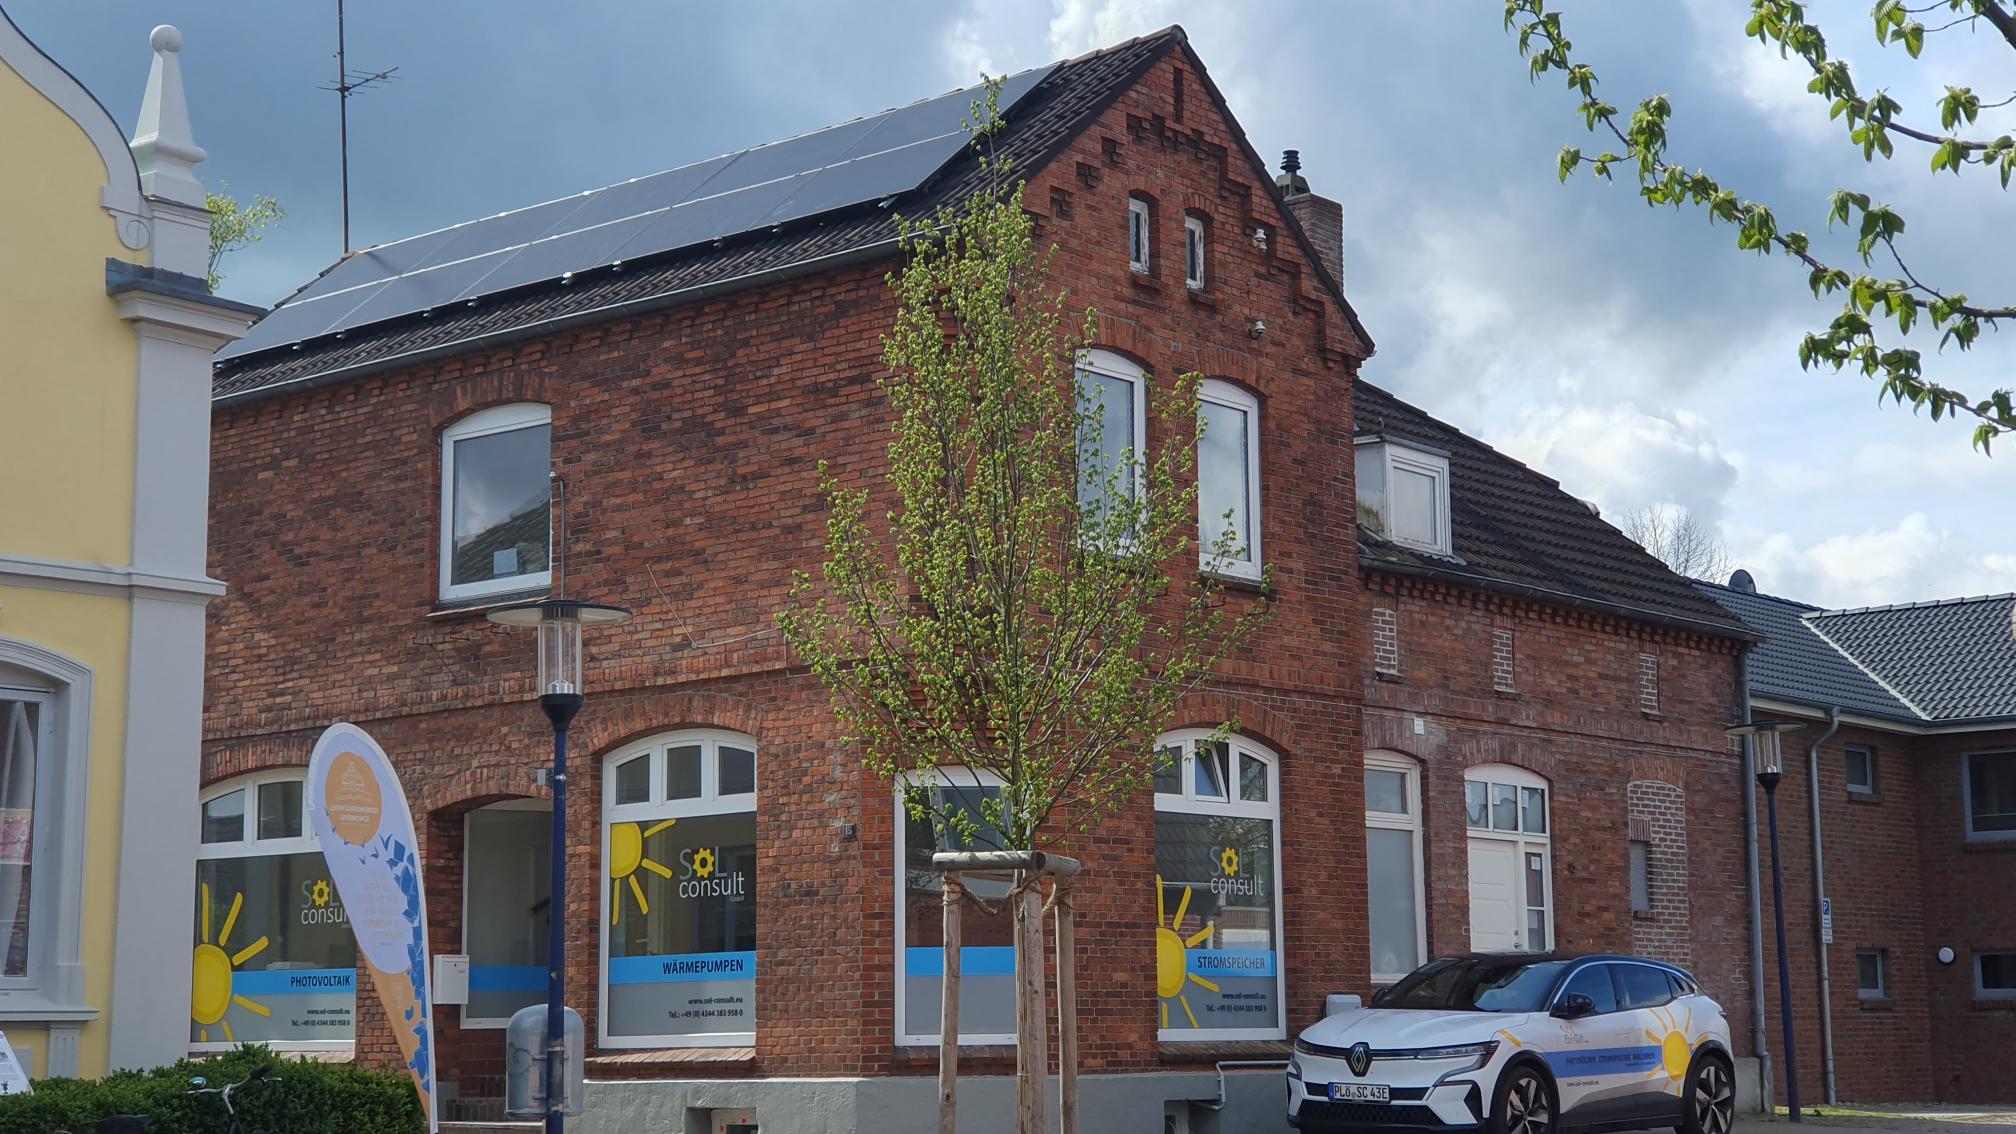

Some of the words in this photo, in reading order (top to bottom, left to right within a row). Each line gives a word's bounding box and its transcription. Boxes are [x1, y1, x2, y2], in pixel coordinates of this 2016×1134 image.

[679, 846, 728, 880] SOL
[1209, 846, 1250, 878] SOL
[679, 871, 745, 899] consult
[1210, 874, 1264, 896] consult
[662, 959, 744, 975] WÄRMEPUMPEN
[1197, 955, 1266, 970] STROMSPEICHER
[290, 975, 351, 988] PHOTOVOLTAIK
[1334, 1085, 1351, 1098] PLÖ
[1356, 1086, 1368, 1099] SC
[1370, 1087, 1389, 1100] 43E
